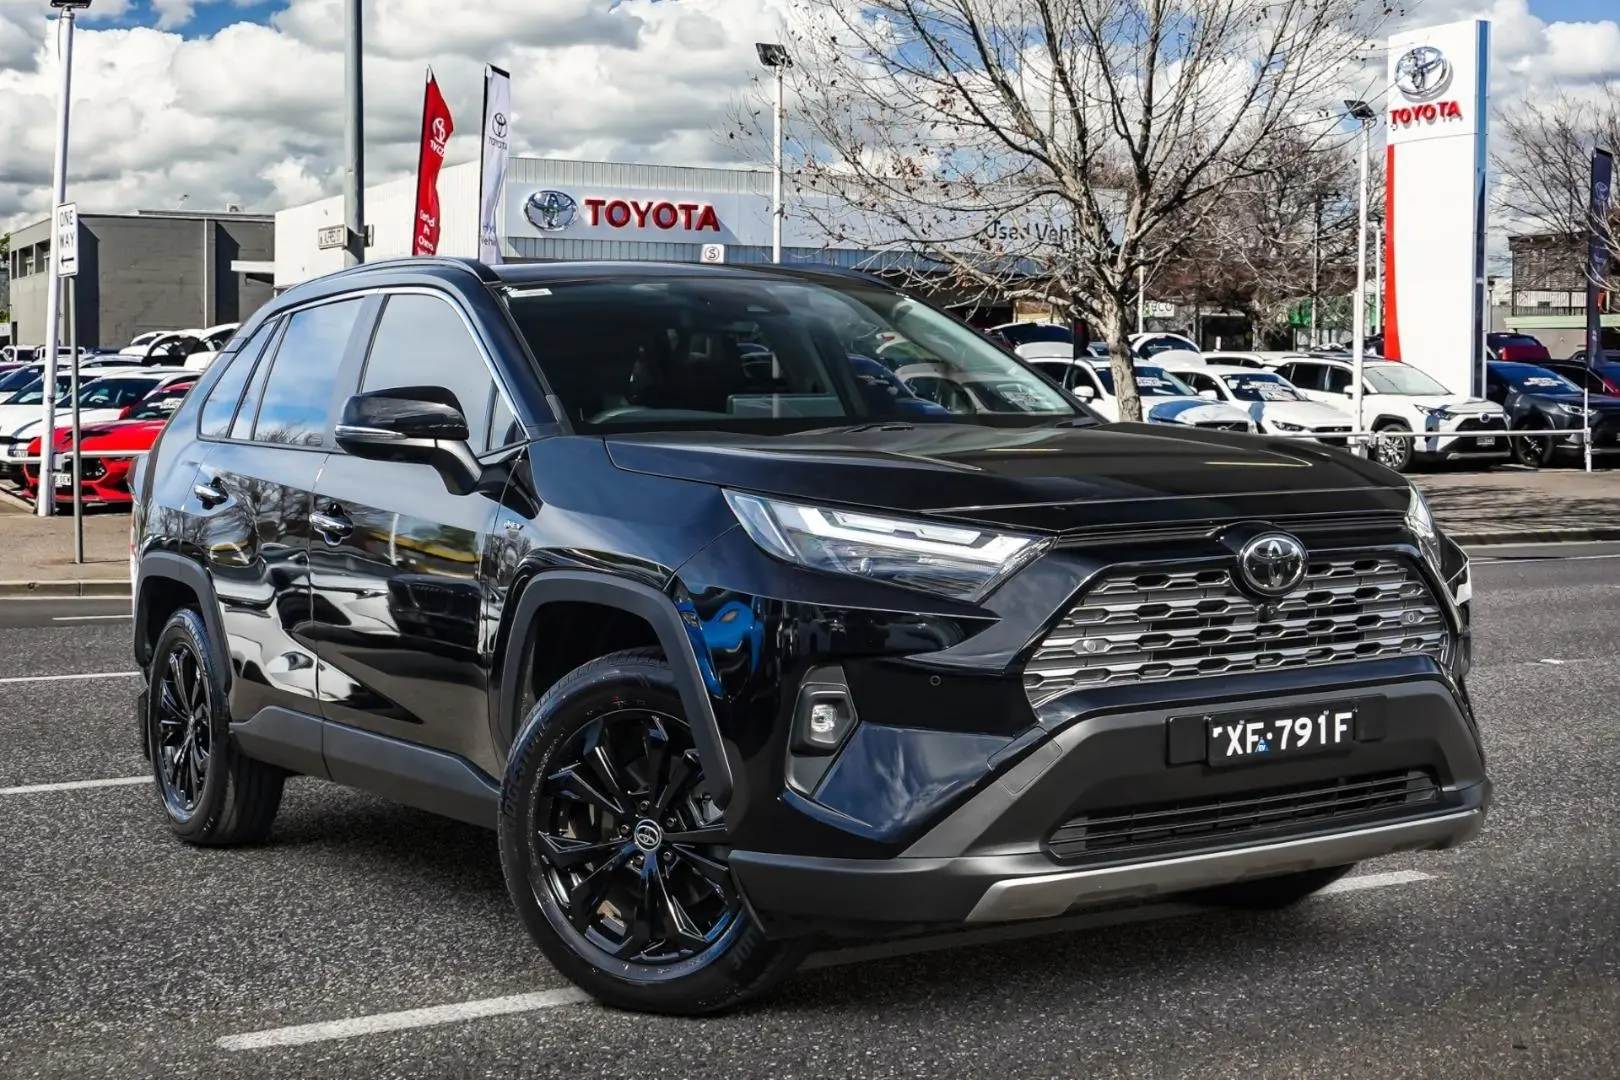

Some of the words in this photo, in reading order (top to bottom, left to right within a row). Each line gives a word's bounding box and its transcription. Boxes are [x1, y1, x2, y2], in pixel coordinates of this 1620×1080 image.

[1389, 100, 1462, 124] TOYOTA
[59, 209, 74, 228] ONE
[584, 198, 721, 232] TOYOTA
[59, 231, 75, 249] WAY
